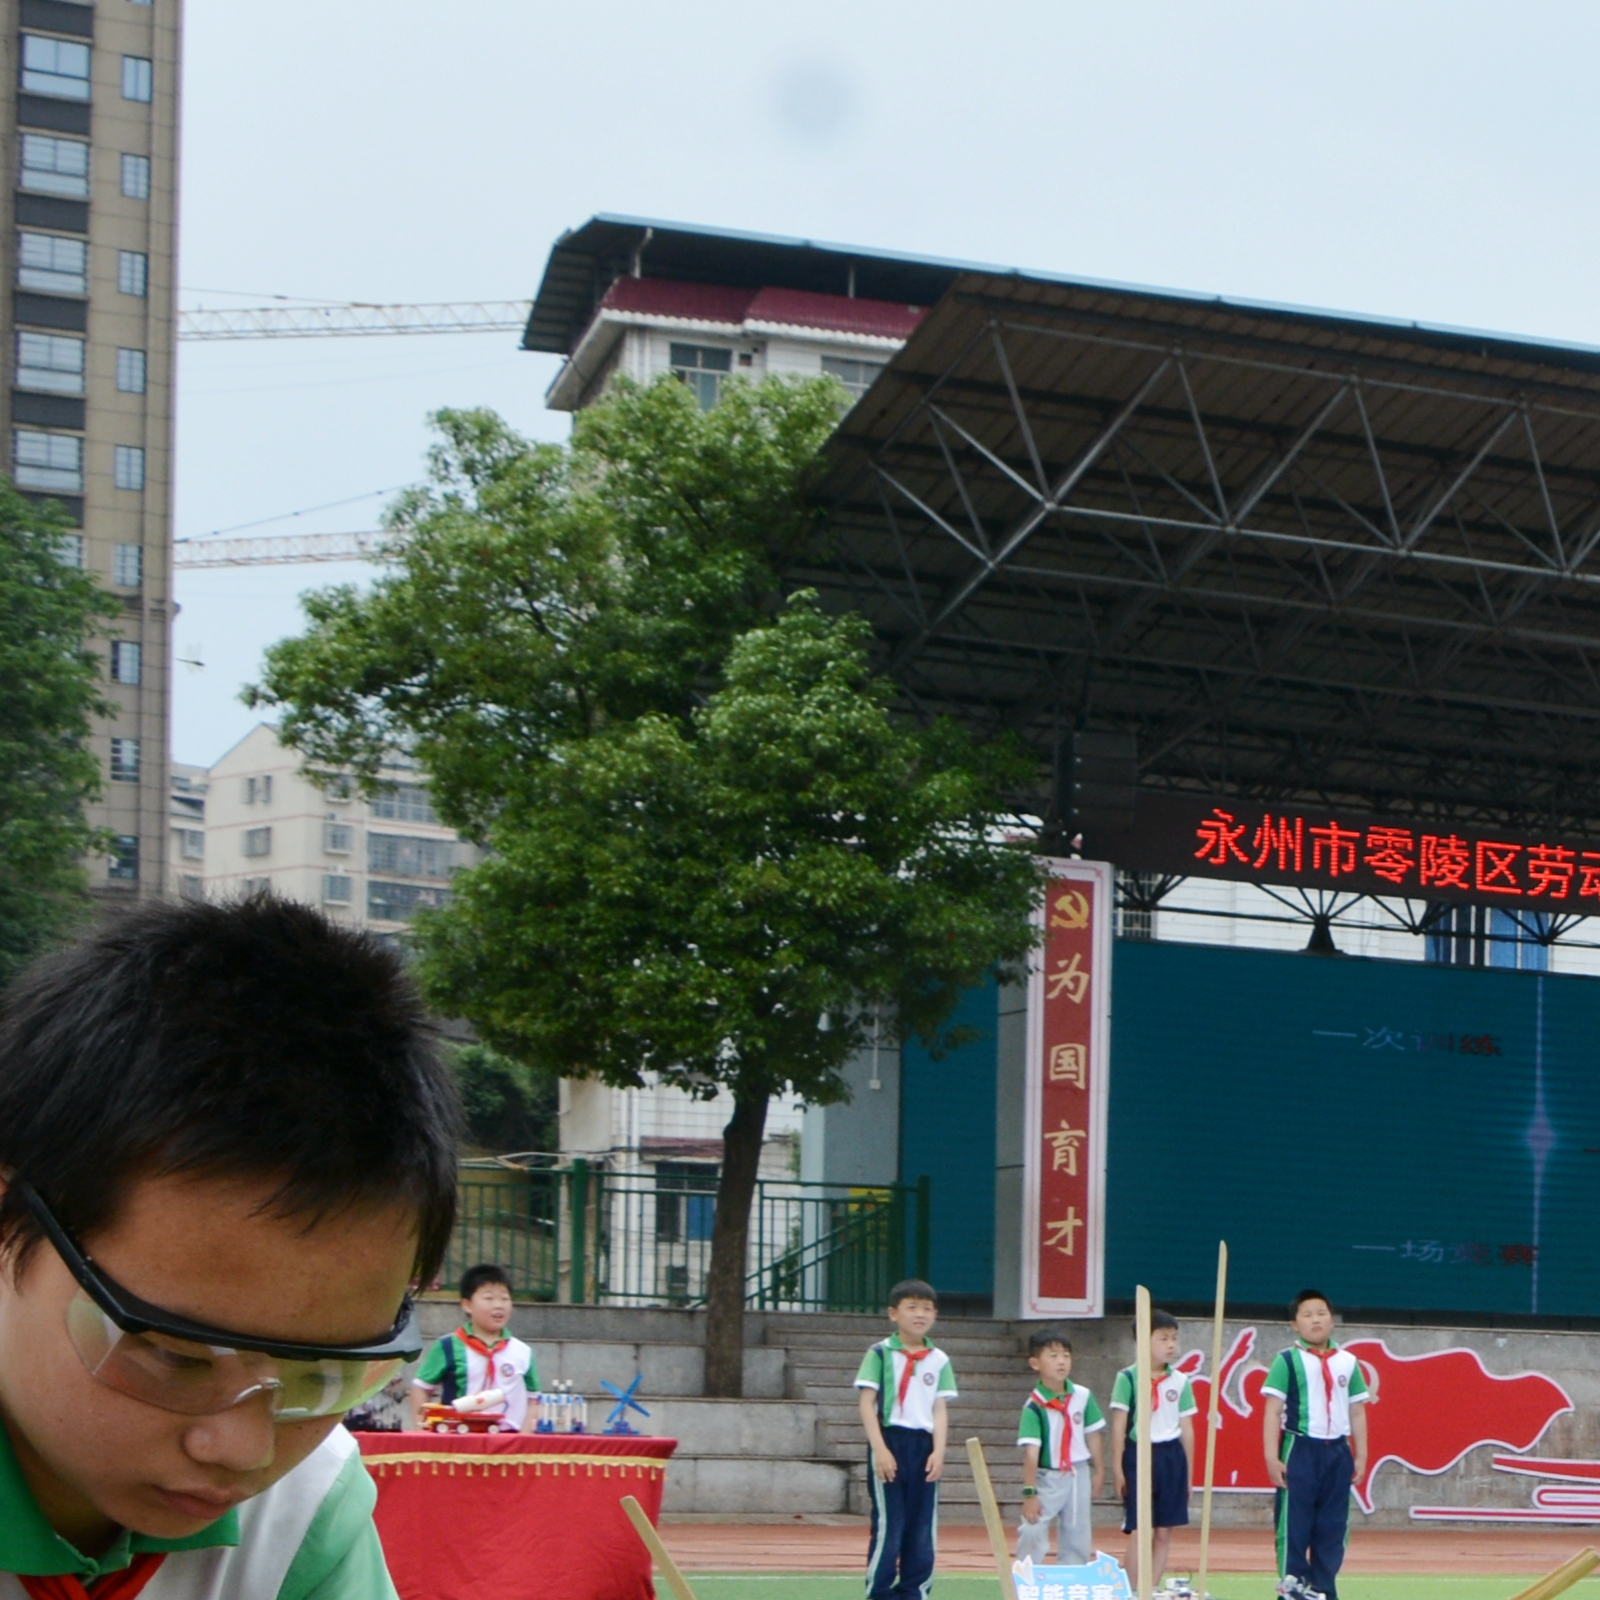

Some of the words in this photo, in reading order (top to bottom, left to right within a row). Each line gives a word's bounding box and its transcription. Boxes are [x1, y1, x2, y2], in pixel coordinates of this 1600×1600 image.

[1043, 958, 1090, 1257] 为国育才
[1312, 1026, 1503, 1058] 一次训练
